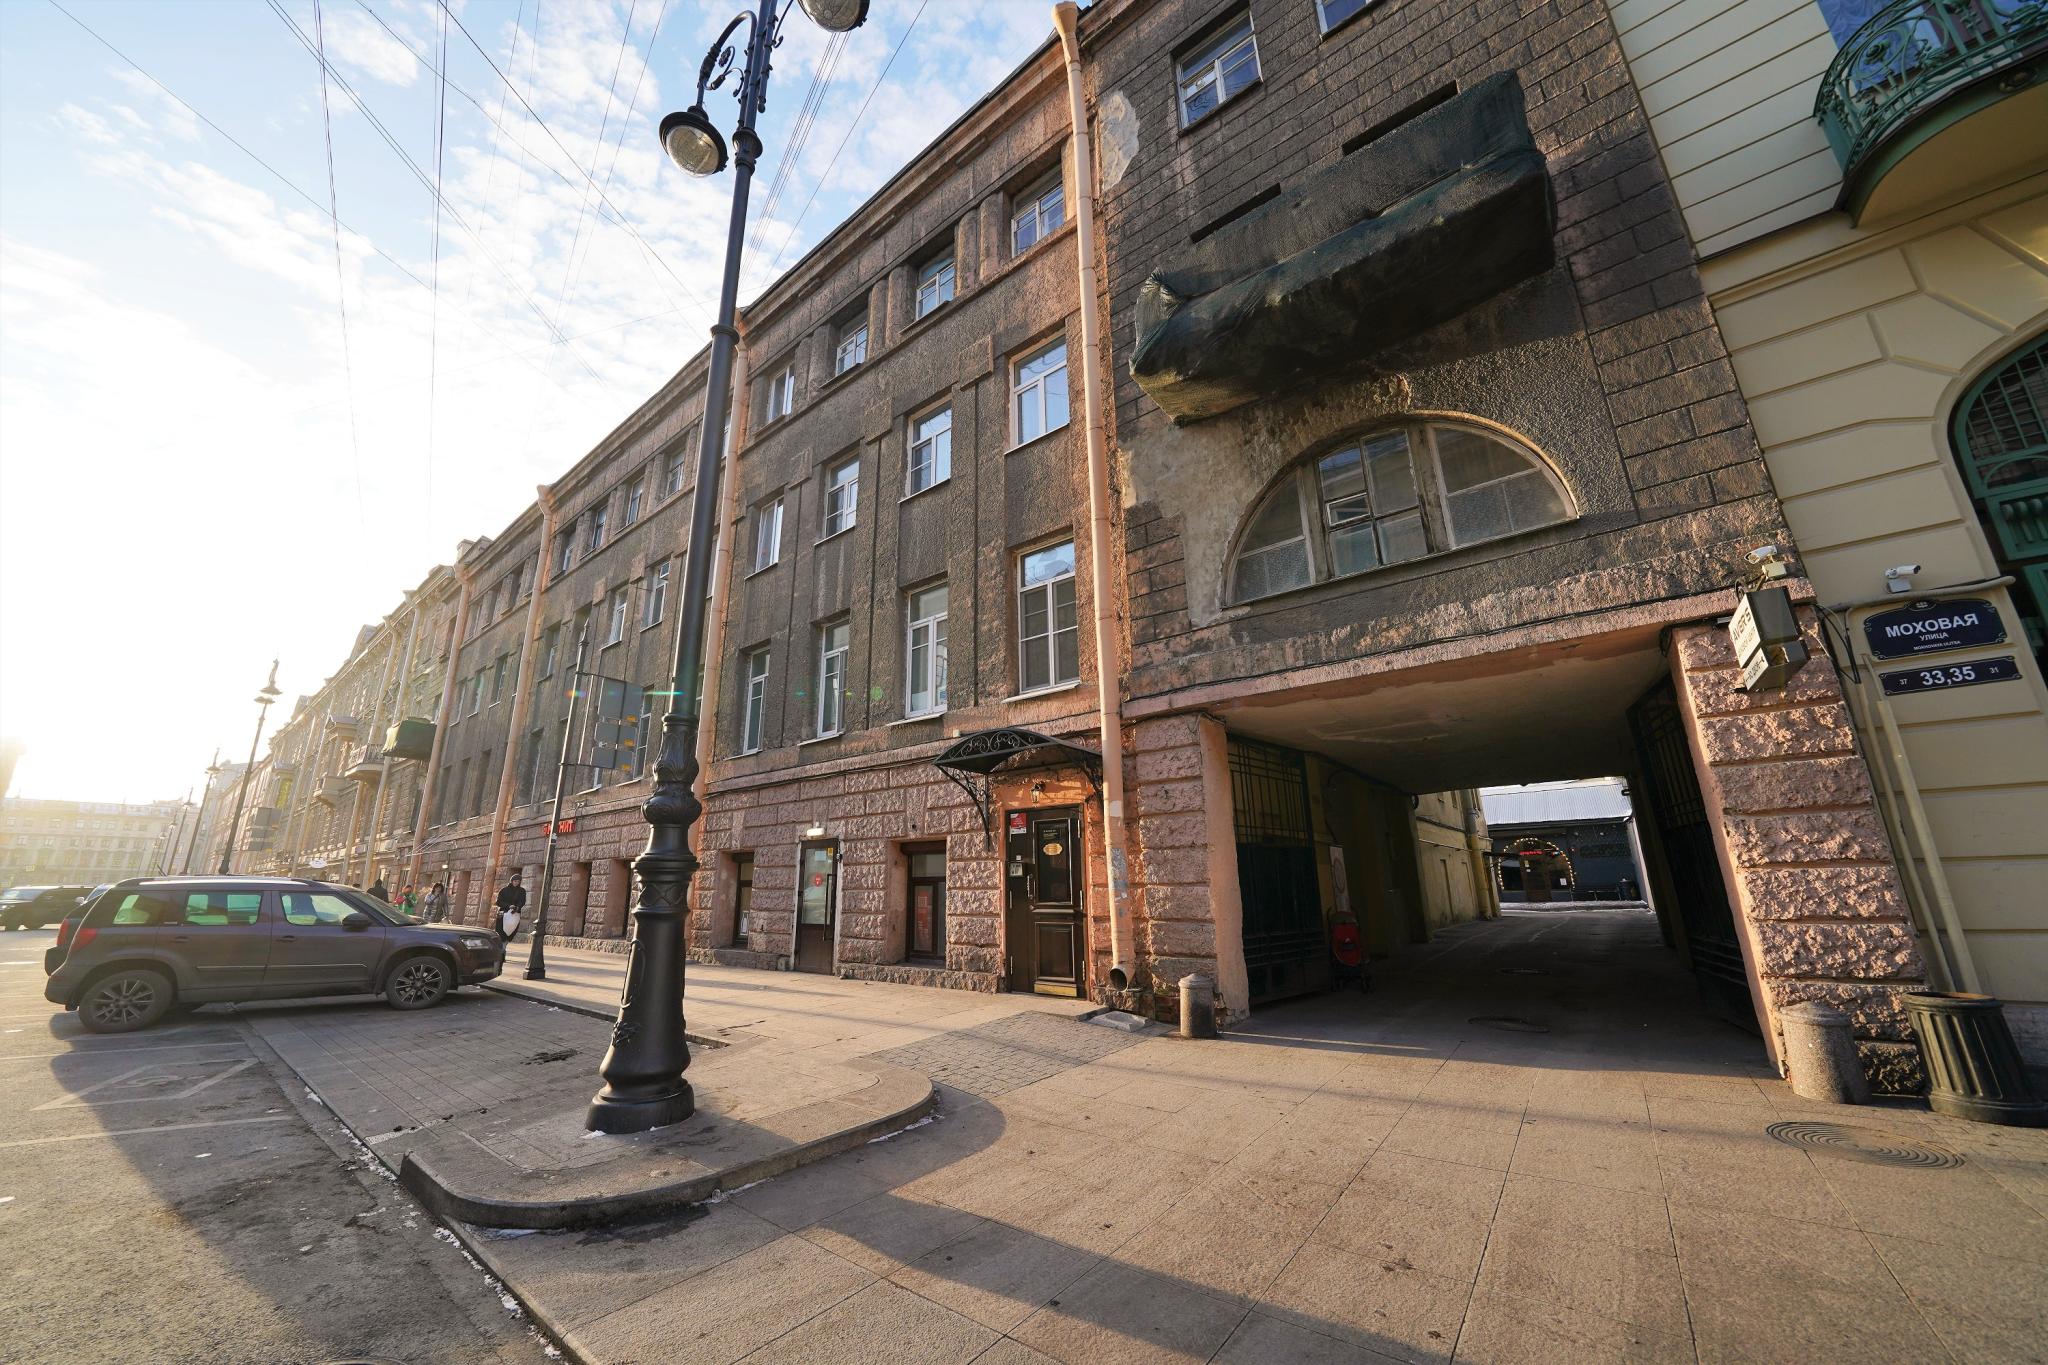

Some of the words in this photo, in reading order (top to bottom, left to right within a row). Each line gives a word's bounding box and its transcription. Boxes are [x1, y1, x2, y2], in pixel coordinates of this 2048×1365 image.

[1885, 613, 1979, 637] МОХОВАЯ
[1920, 632, 1949, 641] УЛИЦА
[1920, 666, 1976, 686] 33,35
